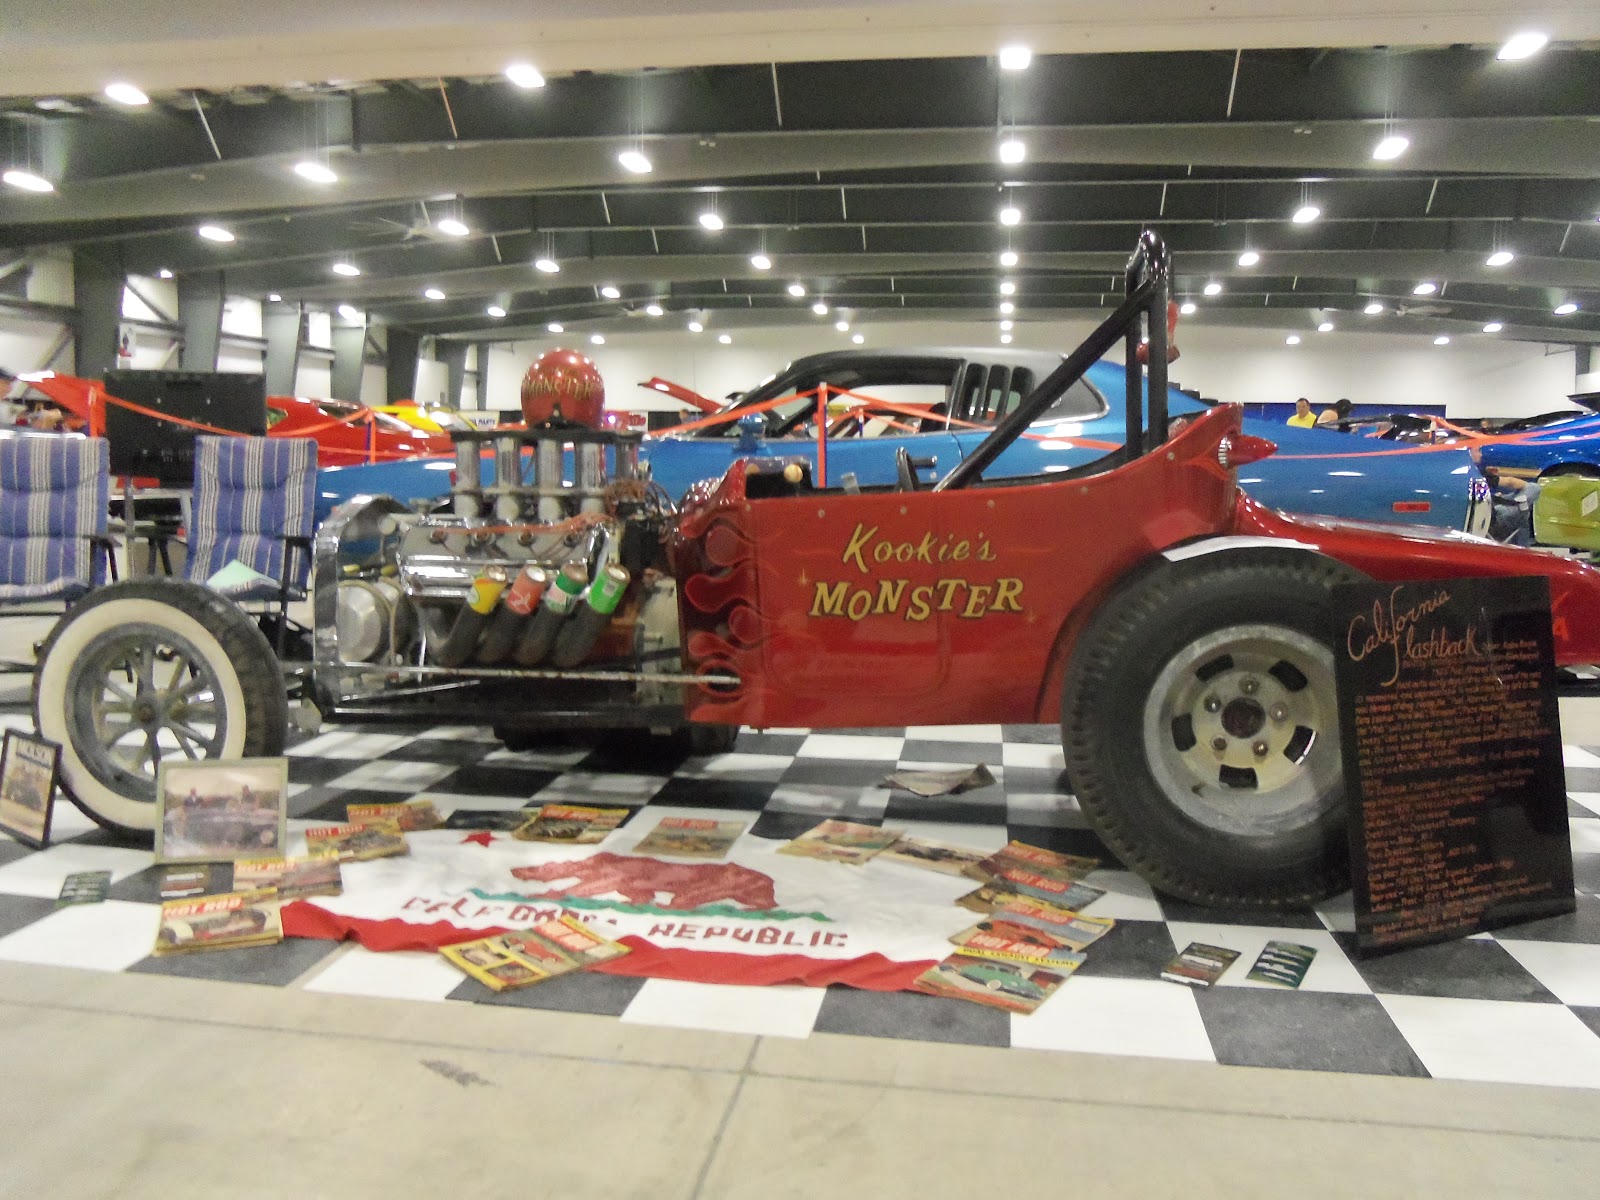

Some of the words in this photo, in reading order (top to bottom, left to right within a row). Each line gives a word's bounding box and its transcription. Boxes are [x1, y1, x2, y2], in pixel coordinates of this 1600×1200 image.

[842, 522, 997, 573] Kookie's
[809, 577, 1024, 621] MONSTER
[1347, 585, 1450, 688] California
[648, 923, 849, 948] REPUBLIC
